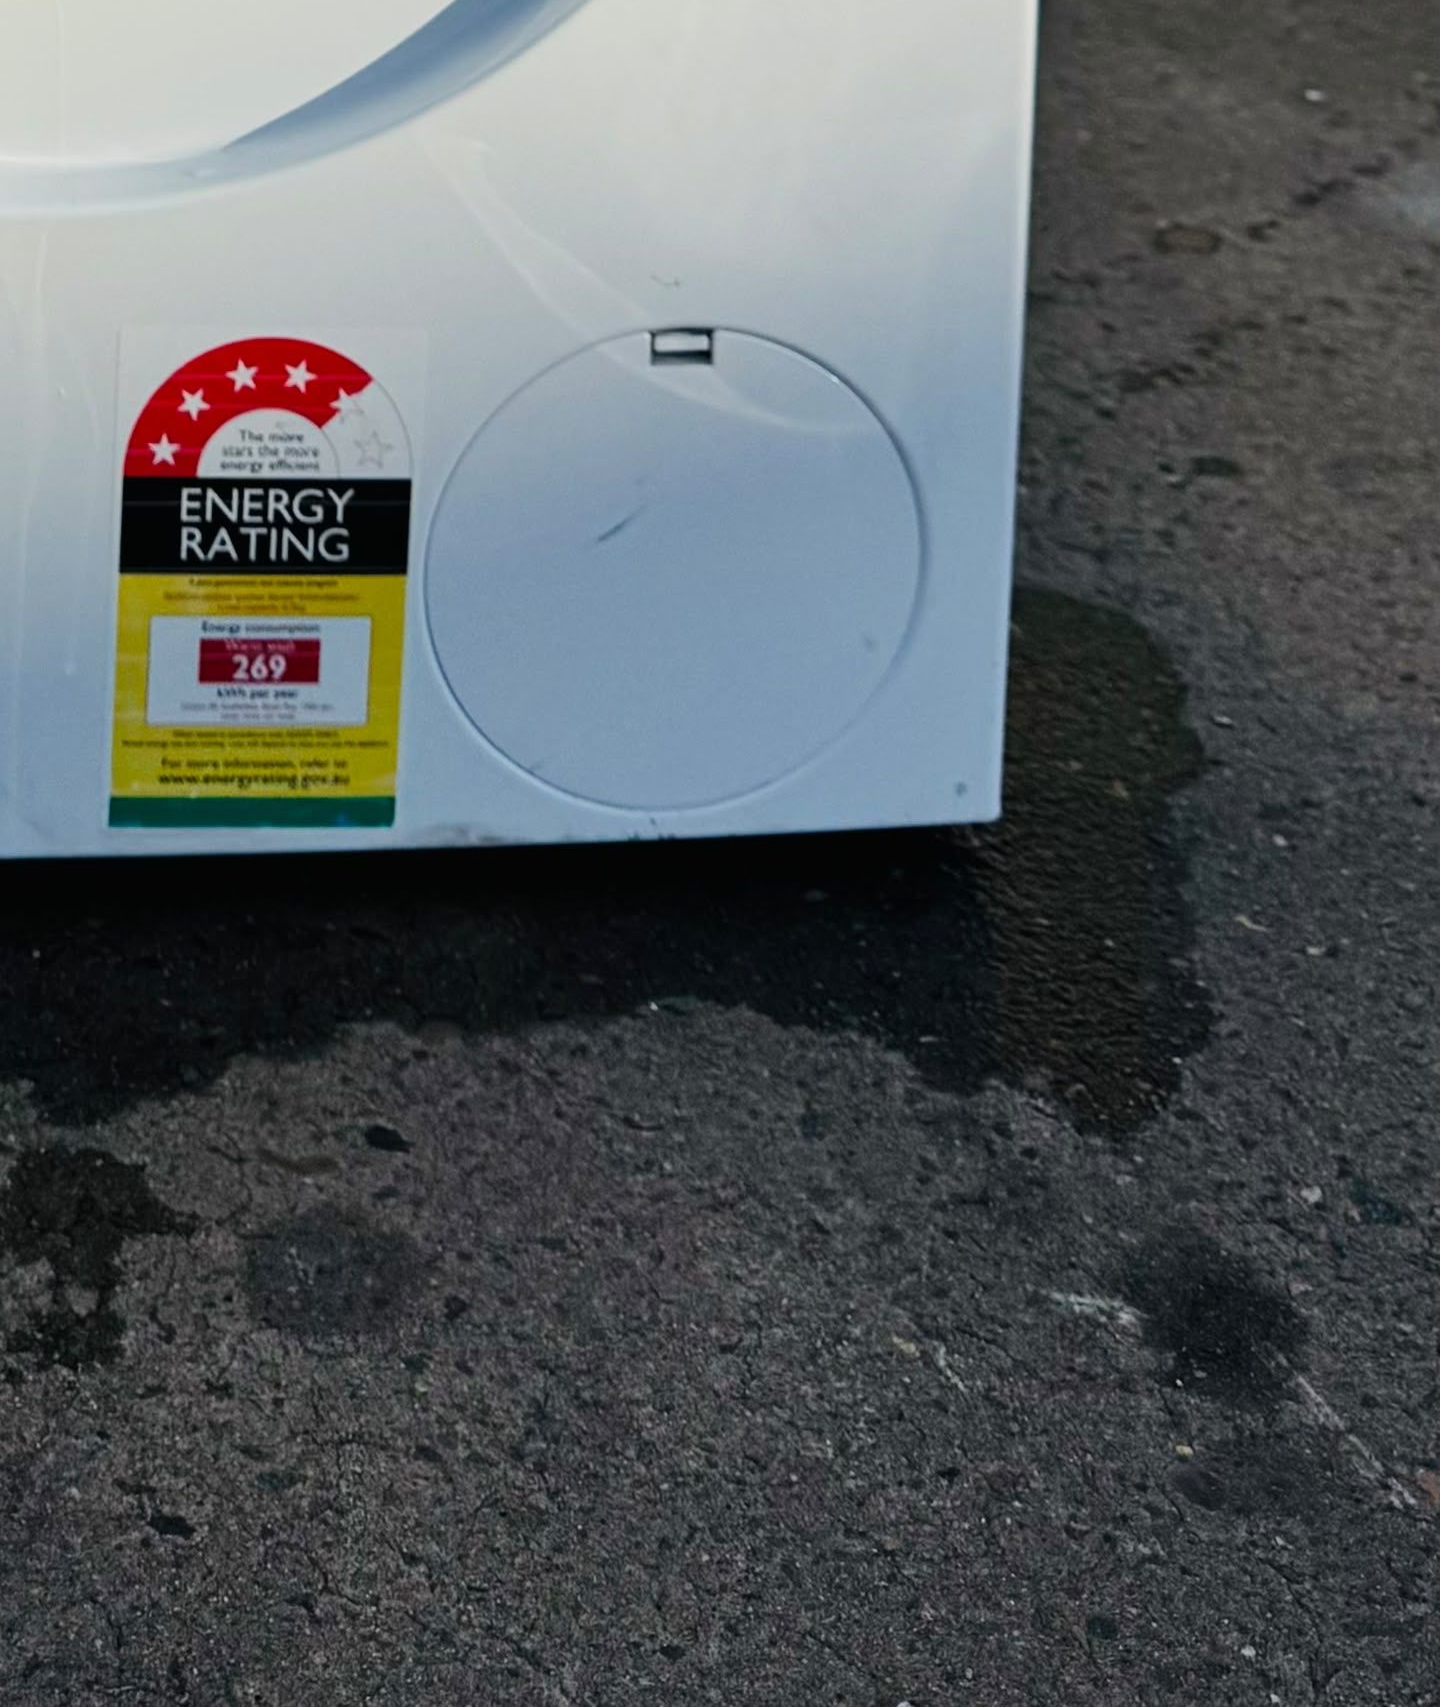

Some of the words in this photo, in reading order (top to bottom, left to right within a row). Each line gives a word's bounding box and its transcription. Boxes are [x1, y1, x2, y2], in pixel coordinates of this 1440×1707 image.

[239, 429, 263, 442] The
[268, 431, 304, 442] more
[221, 446, 254, 458] stars
[258, 445, 280, 458] the
[284, 447, 320, 458] more
[220, 461, 263, 474] energy
[268, 460, 320, 472] efficient
[179, 486, 356, 524] ENERGY
[179, 525, 351, 563] RATING
[201, 620, 242, 635] Energy
[232, 653, 288, 680] 269
